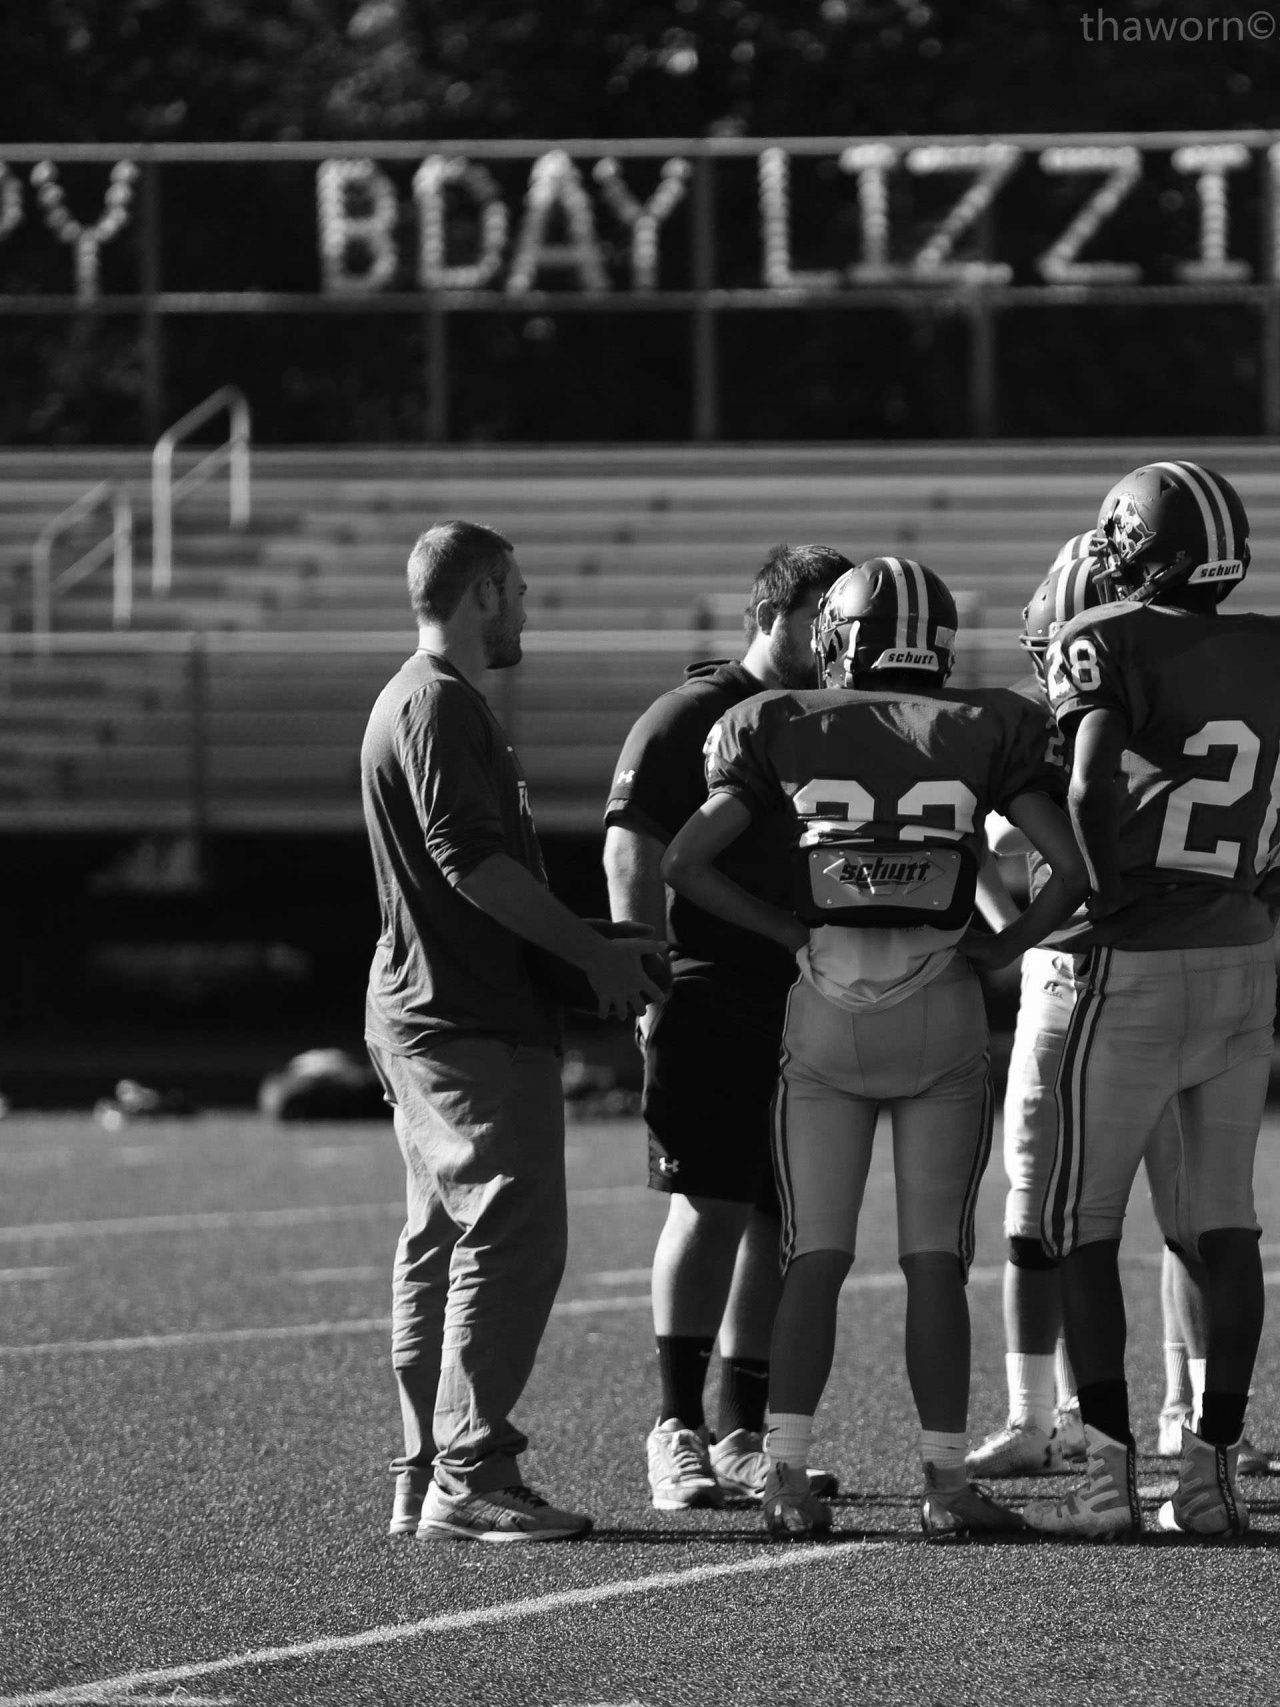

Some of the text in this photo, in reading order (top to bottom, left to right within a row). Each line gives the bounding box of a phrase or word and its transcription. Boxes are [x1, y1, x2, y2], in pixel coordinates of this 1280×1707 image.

[317, 154, 690, 297] BDAY
[887, 651, 934, 665] schutt
[840, 857, 931, 883] schutt
